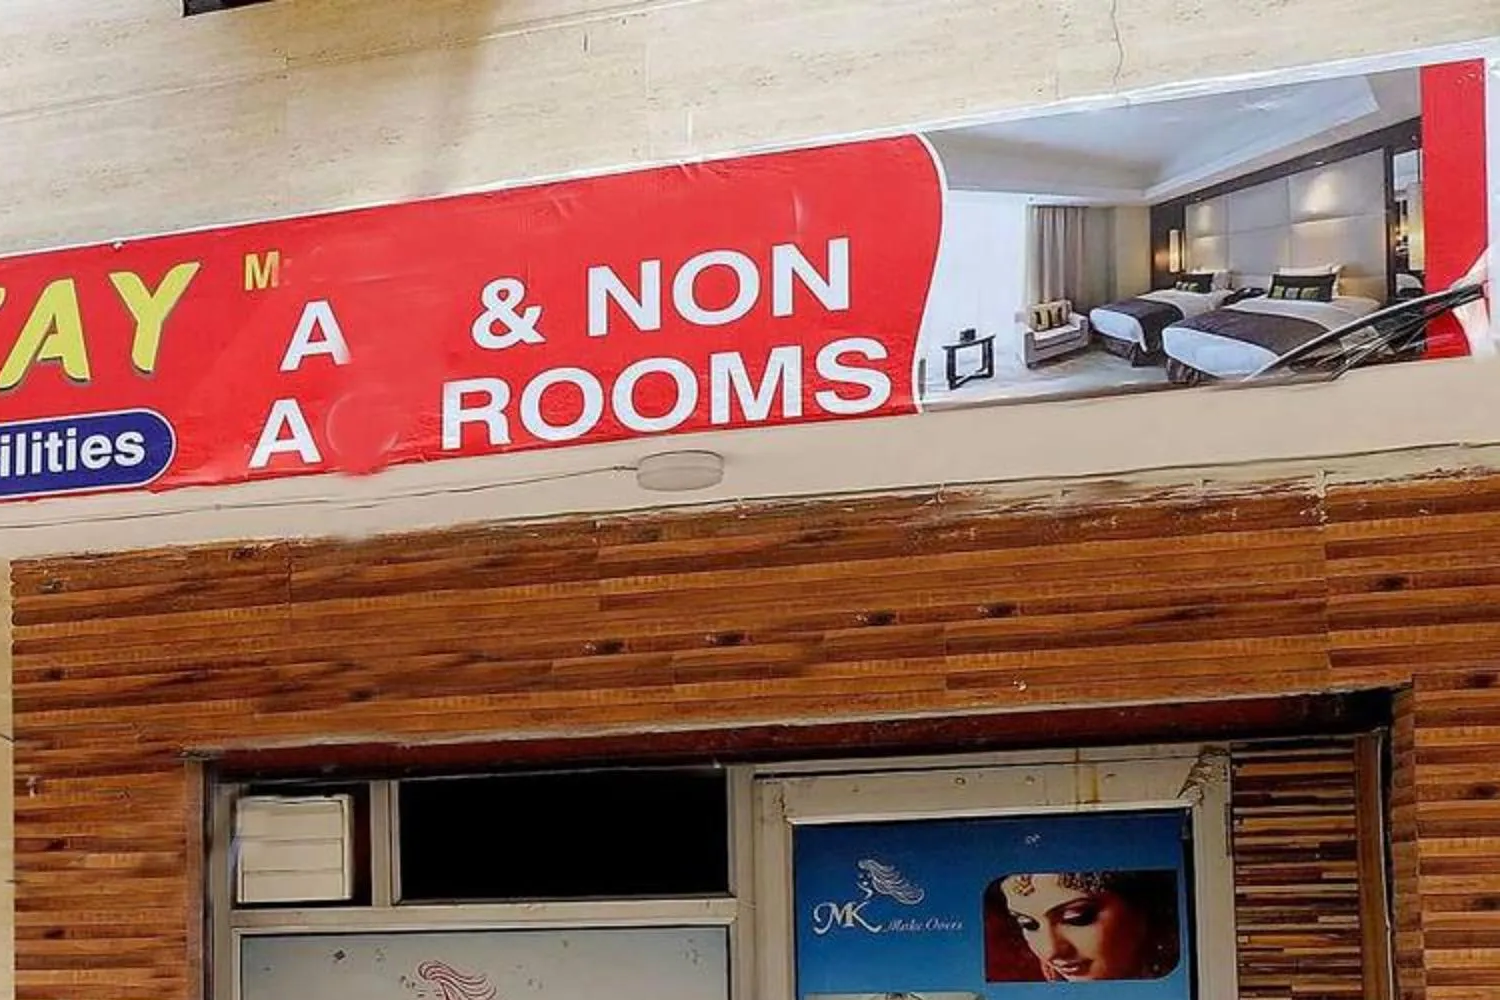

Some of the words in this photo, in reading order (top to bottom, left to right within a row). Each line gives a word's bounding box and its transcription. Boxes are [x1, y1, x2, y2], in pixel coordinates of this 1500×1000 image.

[470, 277, 545, 349] &
[586, 237, 850, 337] NON
[441, 336, 892, 450] ROOMS
